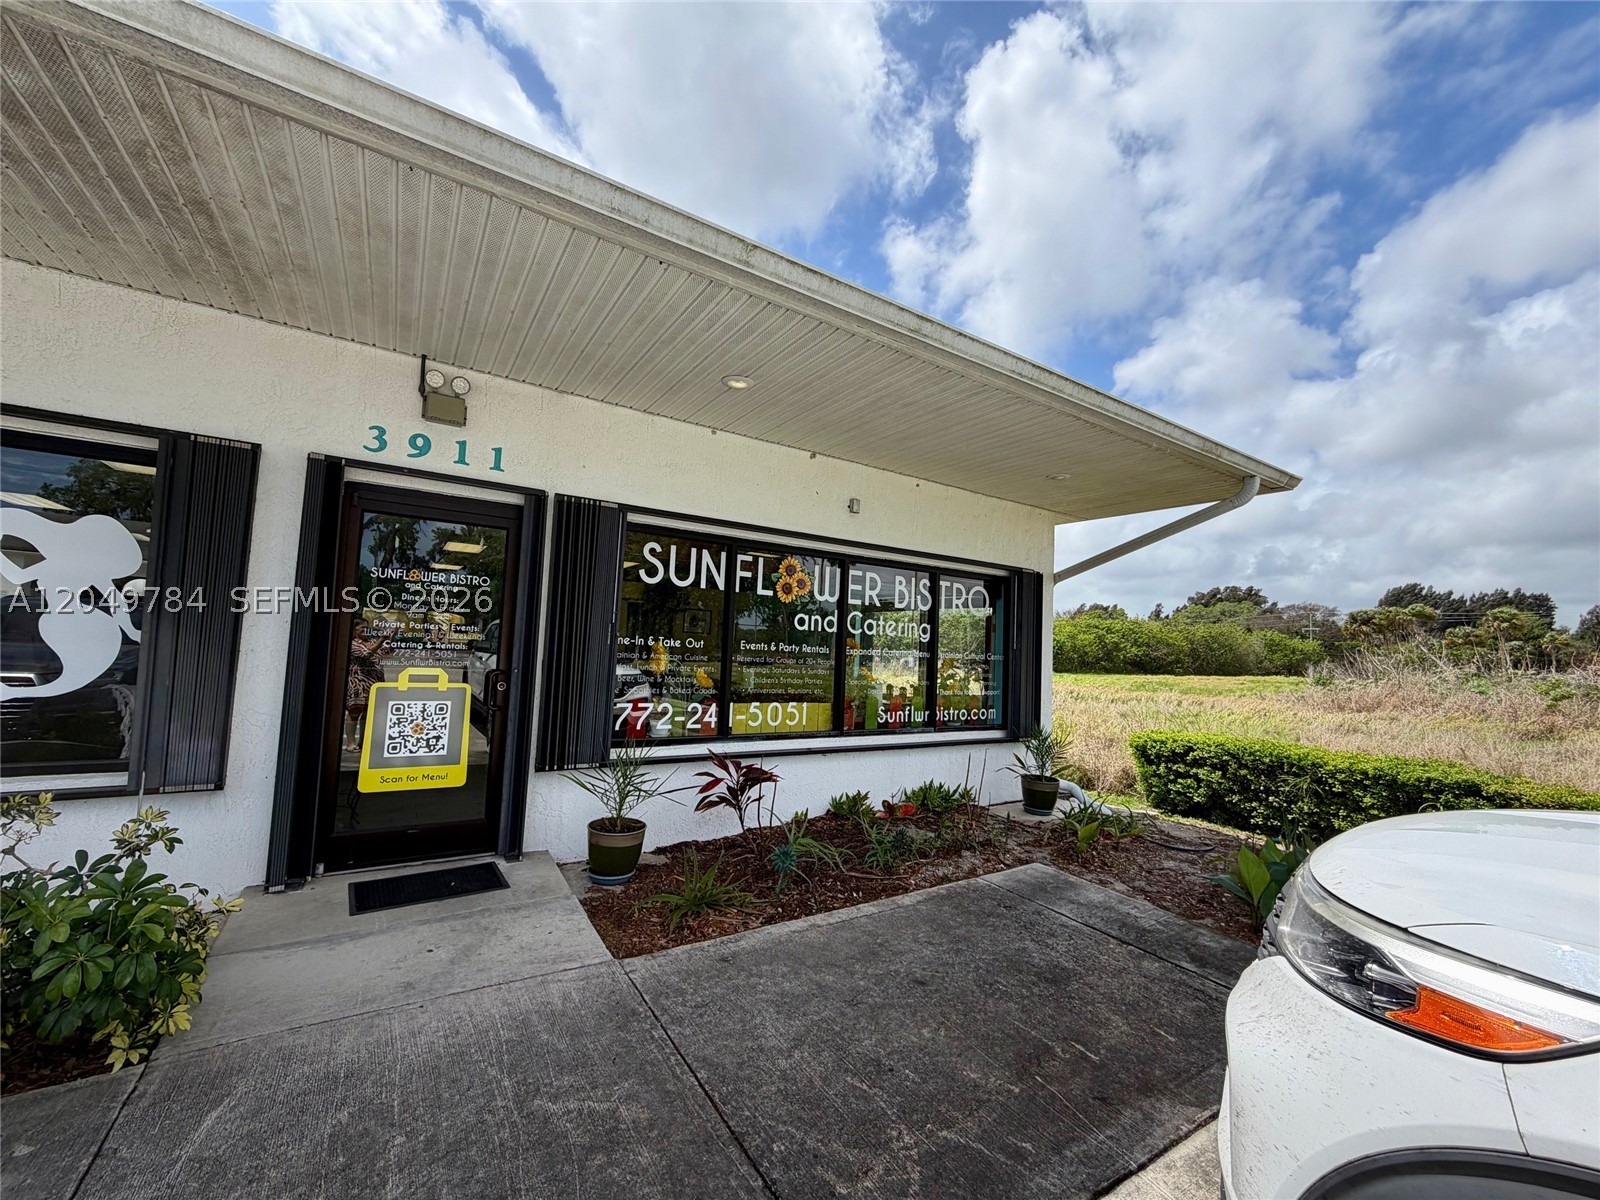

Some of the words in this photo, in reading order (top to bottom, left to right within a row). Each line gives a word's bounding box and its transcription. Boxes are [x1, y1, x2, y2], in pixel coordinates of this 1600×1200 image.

[363, 425, 505, 472] 3911
[450, 573, 490, 586] BISTRO
[405, 582, 421, 590] and
[424, 583, 458, 592] Catering
[401, 592, 430, 602] Dine-n
[895, 575, 990, 617] BISTRO
[373, 620, 405, 628] Private
[410, 622, 439, 630] Parties
[451, 624, 480, 632] Events:
[794, 607, 838, 633] and
[847, 610, 931, 642] Catering
[364, 629, 394, 637] Weekly
[398, 630, 434, 639] Evenings
[383, 641, 423, 649] Catering
[436, 642, 468, 650] Rentals:
[648, 636, 655, 645] &
[659, 637, 681, 647] Take
[686, 638, 704, 648] Out
[740, 641, 768, 651] Events
[771, 642, 777, 651] &
[779, 643, 799, 653] Party
[802, 644, 829, 654] Rentals
[846, 647, 881, 656] Expanded
[393, 650, 457, 658] 772-241-5051
[684, 654, 708, 662] Cuisine
[776, 657, 796, 665] Groups
[668, 664, 691, 672] Private
[772, 667, 800, 675] Saturdays
[780, 678, 803, 686] Birthday
[614, 702, 807, 730] 772-241-5051
[877, 705, 997, 723] Sunflwristro.com
[380, 776, 403, 784] Scan
[407, 774, 418, 782] for
[422, 773, 448, 781] Menu!
